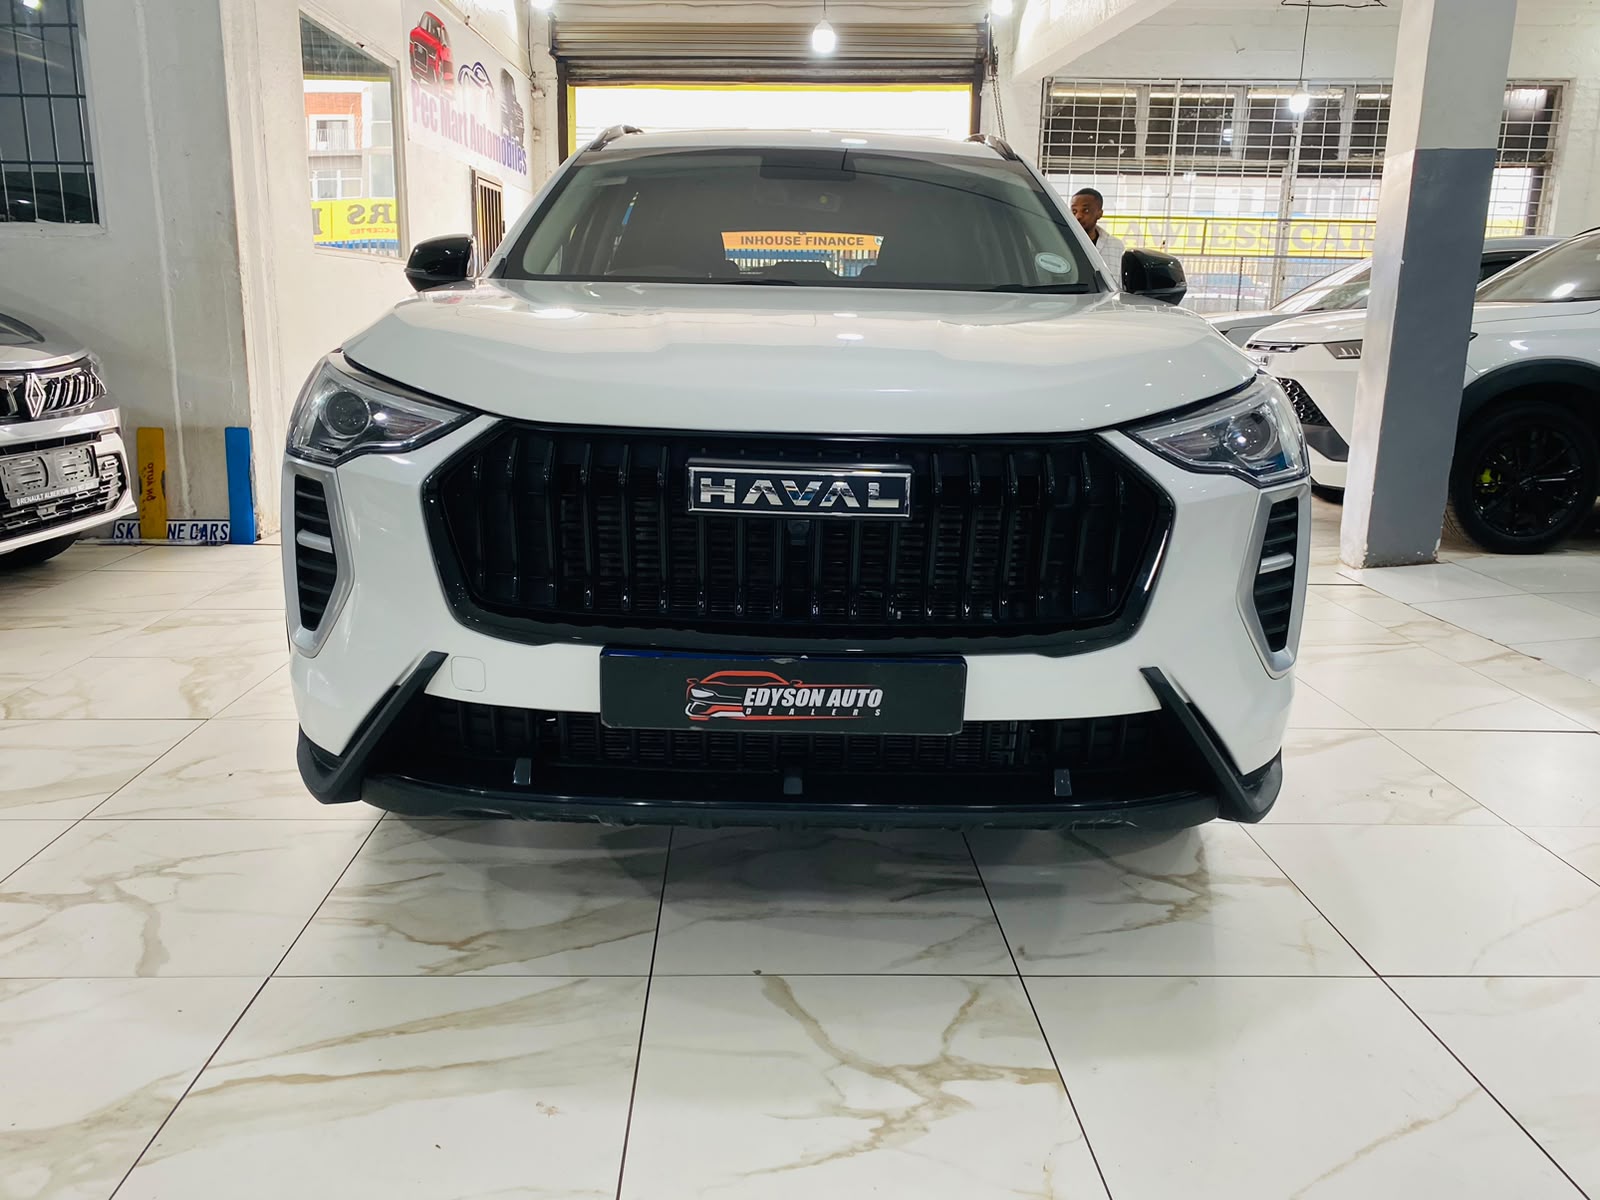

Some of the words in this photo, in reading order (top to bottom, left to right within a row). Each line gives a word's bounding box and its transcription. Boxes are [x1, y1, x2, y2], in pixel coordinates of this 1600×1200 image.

[440, 96, 469, 148] Mart
[470, 113, 527, 176] Automobiles
[740, 235, 801, 246] INHOUSE
[805, 236, 865, 247] FINANCE
[20, 492, 44, 505] RENAULT
[700, 477, 900, 508] HAVAL
[189, 522, 229, 541] CARS
[744, 687, 825, 707] EDYSON
[826, 687, 884, 708] AUTO
[744, 708, 882, 717] DEALERS
